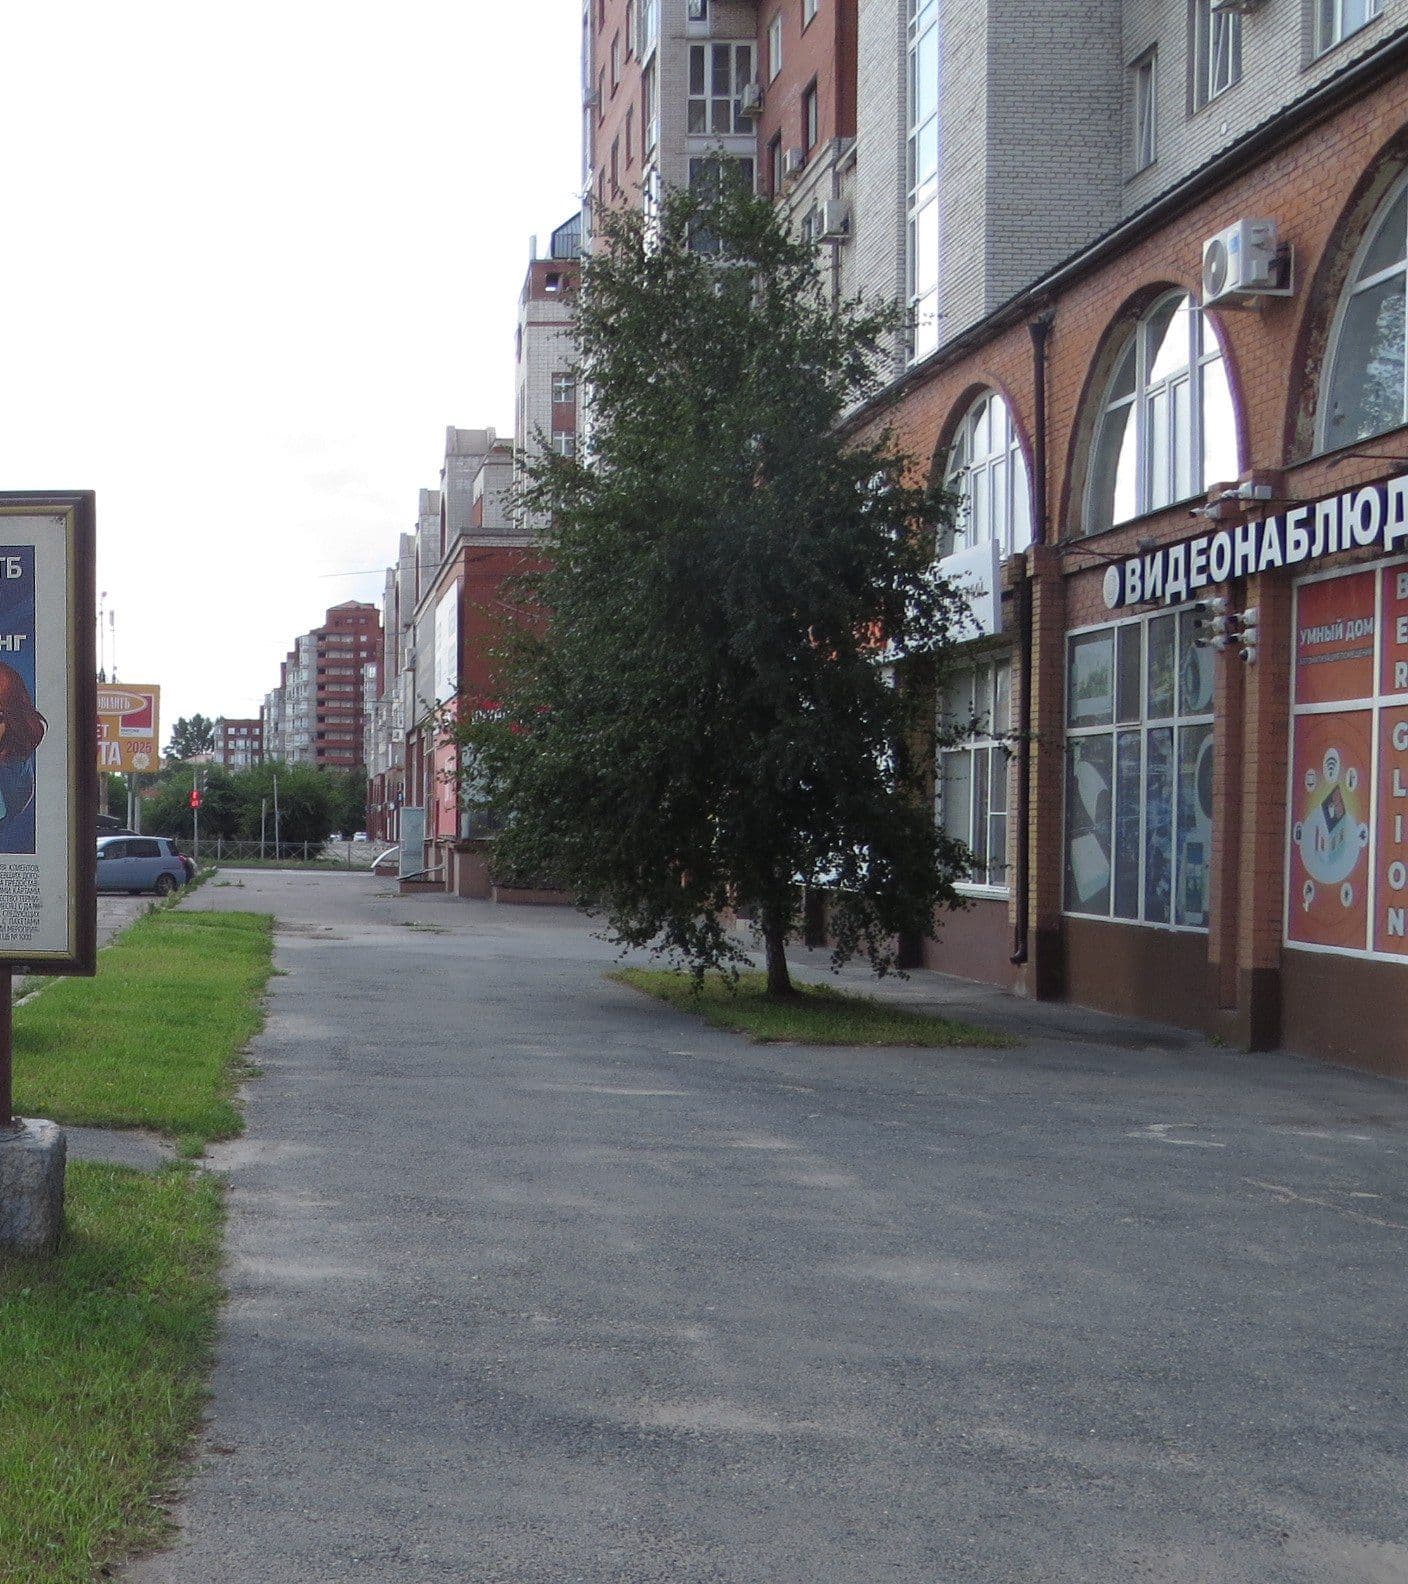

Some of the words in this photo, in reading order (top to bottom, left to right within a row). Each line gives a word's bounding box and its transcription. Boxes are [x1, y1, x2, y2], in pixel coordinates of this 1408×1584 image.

[1125, 475, 1408, 606] ВИДЕОНАБЛЮД
[1300, 618, 1343, 646] УМНЫЙ
[1345, 617, 1374, 641] ДОМ
[127, 741, 152, 753] 2025
